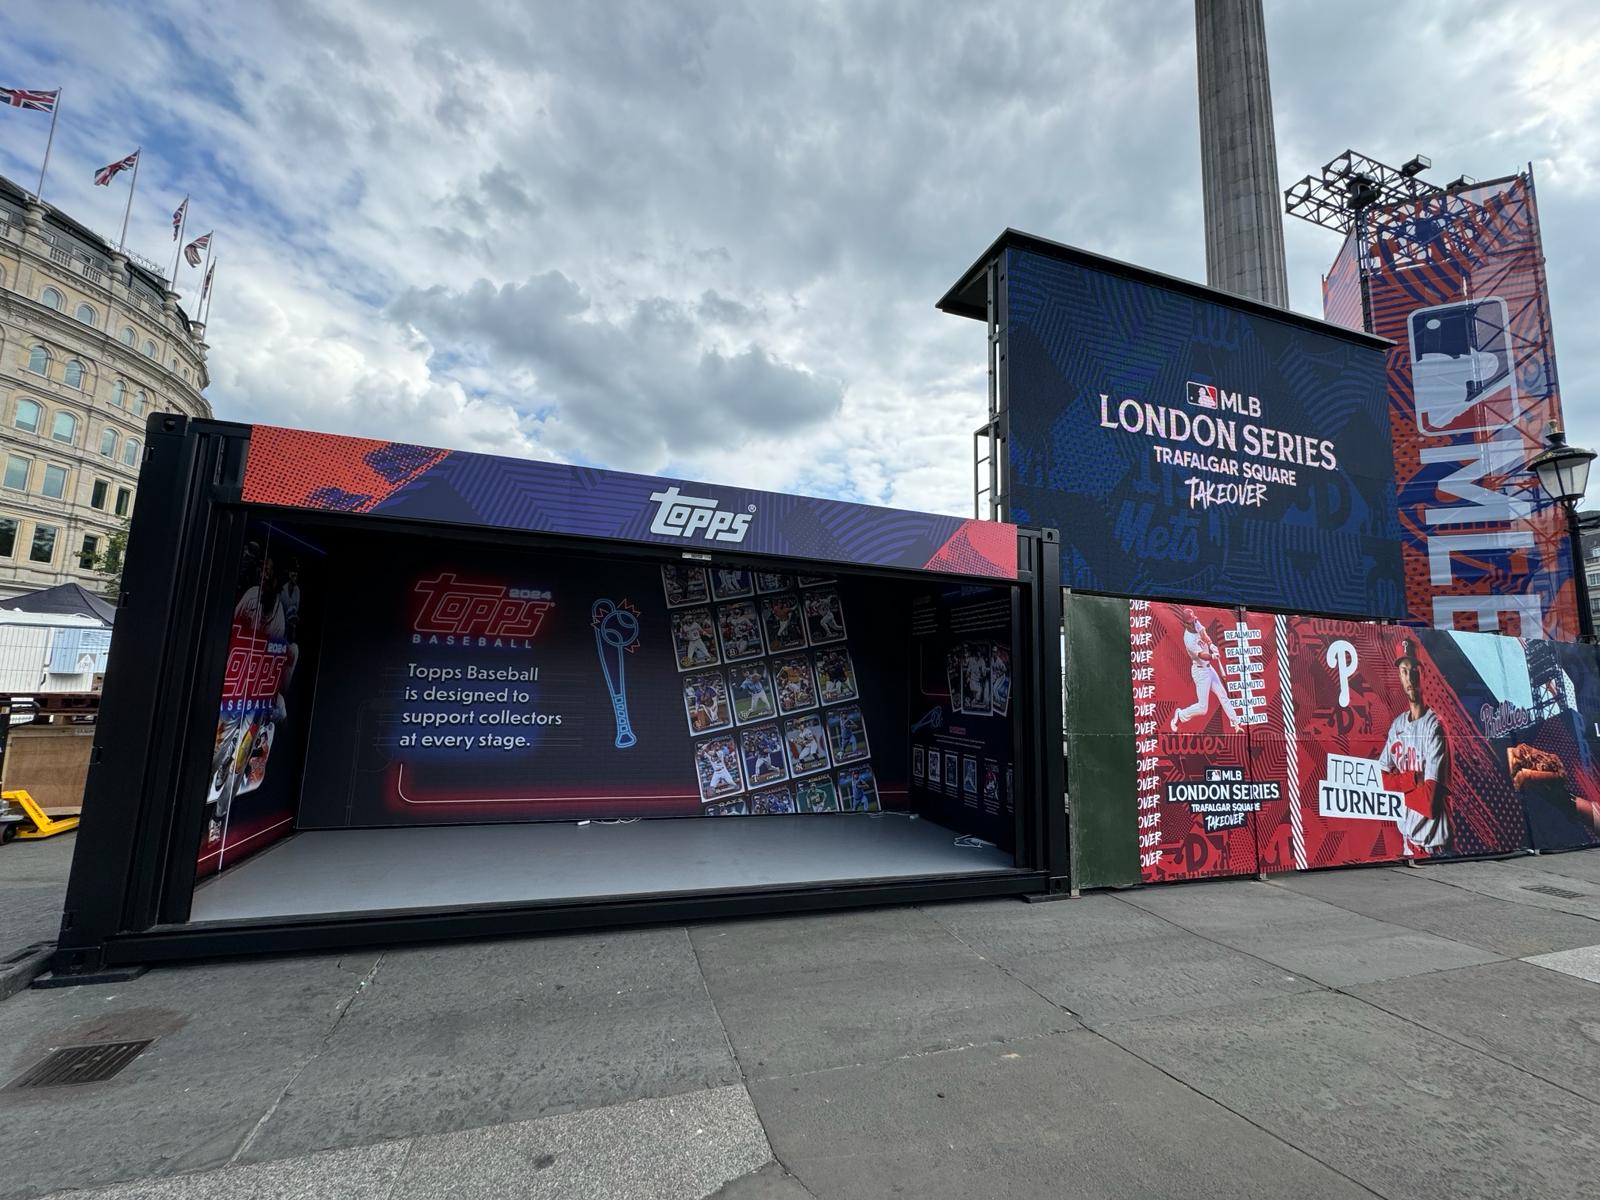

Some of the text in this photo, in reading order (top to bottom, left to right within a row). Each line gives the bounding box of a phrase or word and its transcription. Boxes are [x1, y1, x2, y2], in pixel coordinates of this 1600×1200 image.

[1220, 390, 1261, 418] MLB
[1100, 394, 1337, 471] LONDON SERIES
[1153, 446, 1297, 486] TRAFALGAR SQUARE
[1184, 477, 1268, 509] TAKEOVER
[509, 588, 552, 600] 2024
[412, 634, 532, 649] BASEBALL
[1225, 630, 1260, 640] REALMUTO
[1226, 647, 1261, 657] REALMUTO
[408, 664, 539, 681] Topps Baseball
[1227, 664, 1263, 673] REALMUTO
[1326, 640, 1358, 708] P
[1229, 681, 1264, 691] REALMUTO
[405, 686, 530, 704] is designed to
[402, 710, 562, 726] support collectors
[400, 733, 530, 750] at every stage.
[1222, 770, 1242, 781] MLB
[1330, 758, 1379, 788] TREA
[1168, 783, 1280, 801] LONDON SERIES
[1191, 803, 1231, 812] TRAFALGAR
[1322, 786, 1402, 818] TURNER
[1205, 812, 1245, 830] TAKEOVER
